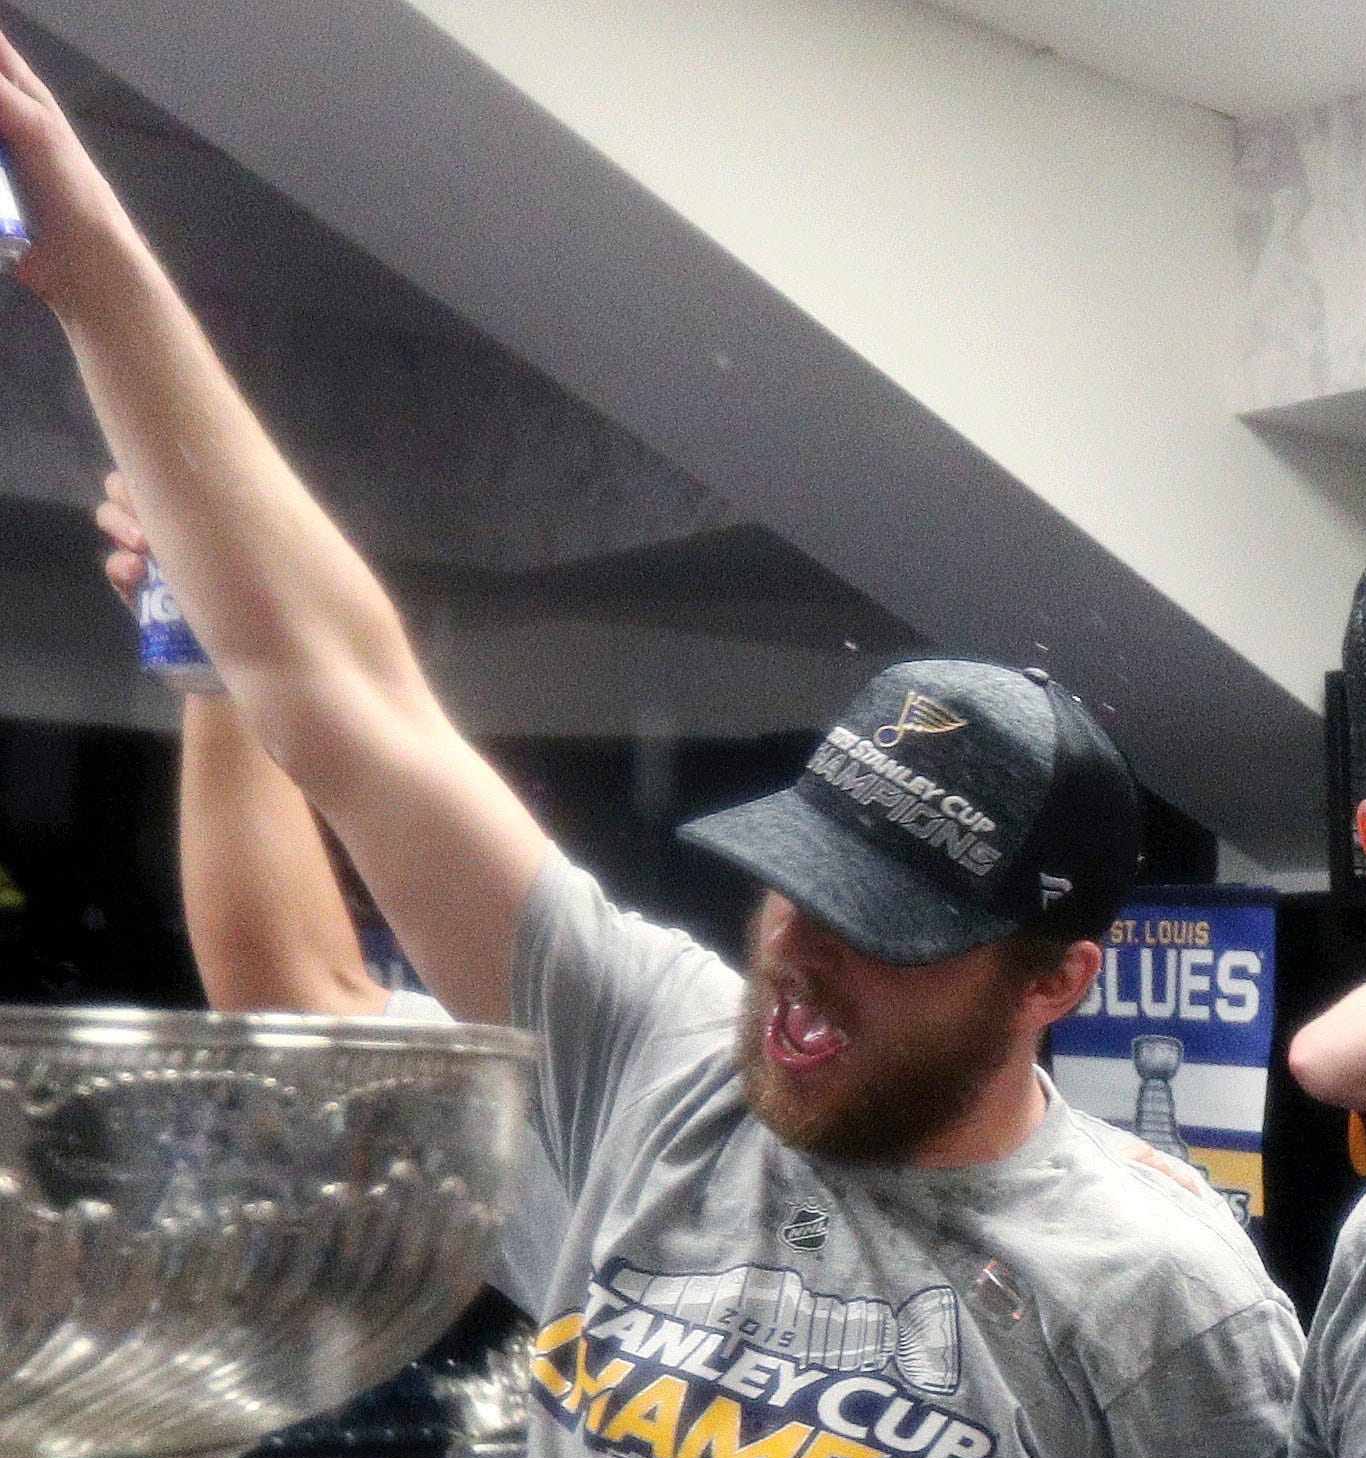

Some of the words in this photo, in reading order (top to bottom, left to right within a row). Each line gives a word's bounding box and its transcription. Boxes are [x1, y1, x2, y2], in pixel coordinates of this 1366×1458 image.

[940, 795, 996, 834] CUP
[1110, 920, 1139, 944] ST.
[1144, 920, 1211, 946] LOUIS
[583, 1280, 829, 1408] TANLEY
